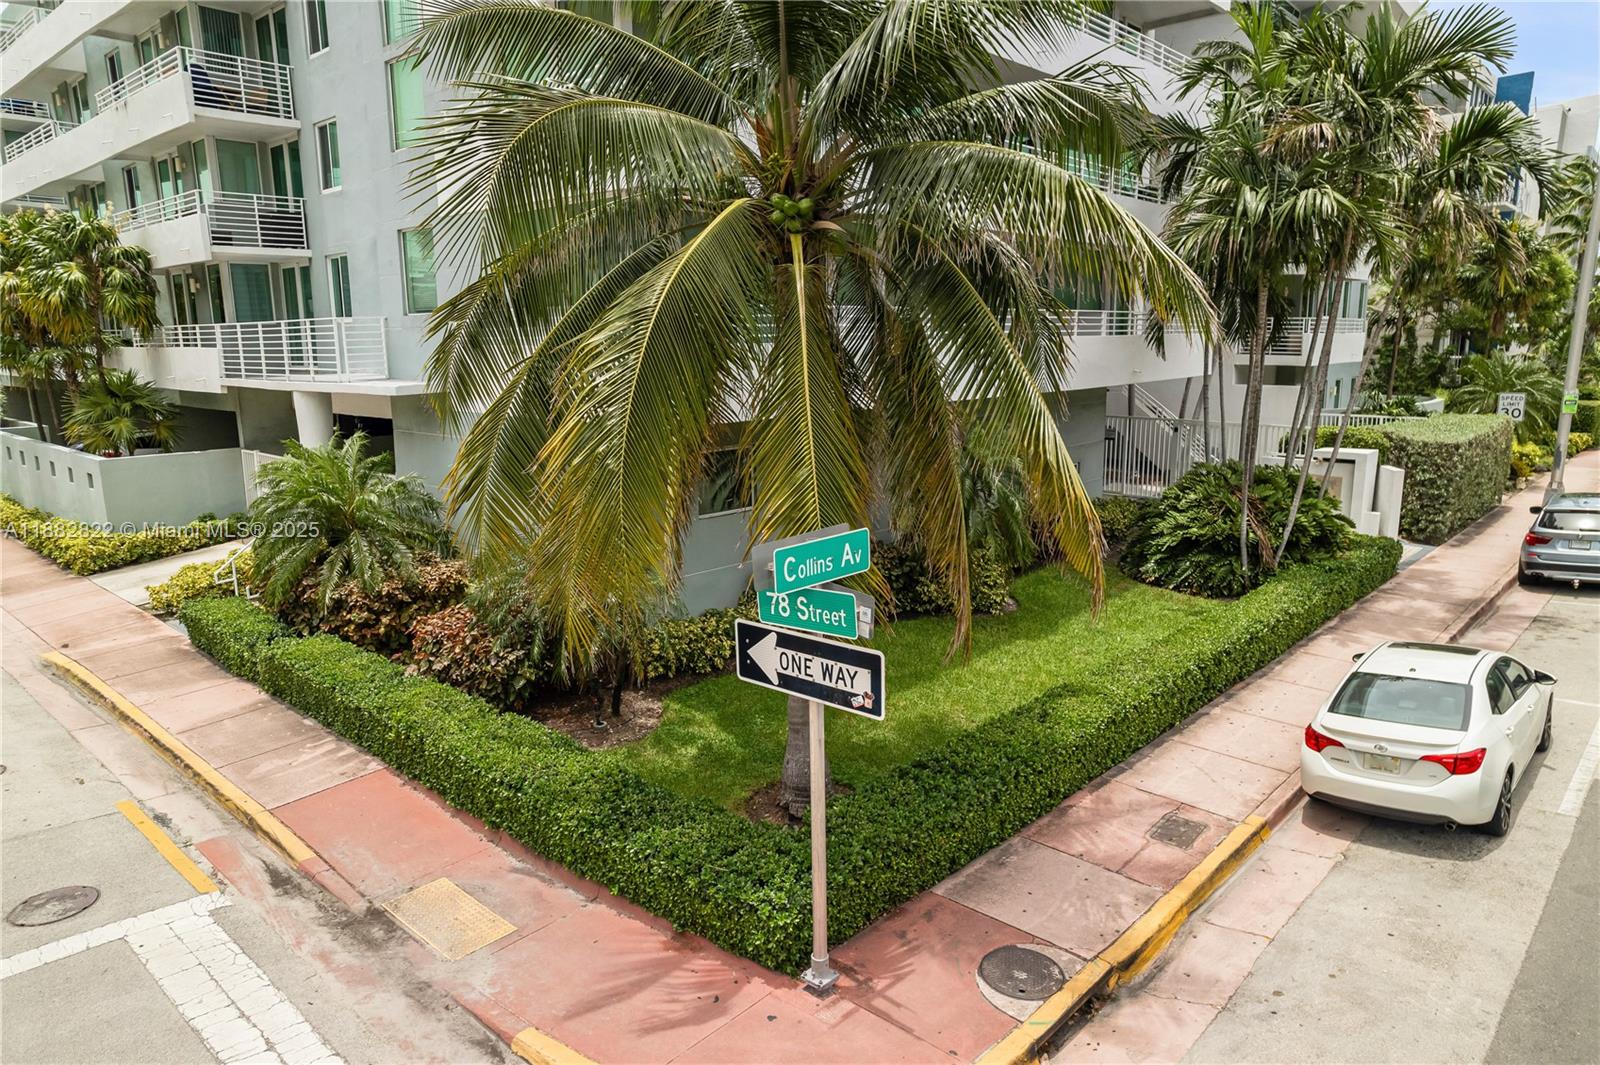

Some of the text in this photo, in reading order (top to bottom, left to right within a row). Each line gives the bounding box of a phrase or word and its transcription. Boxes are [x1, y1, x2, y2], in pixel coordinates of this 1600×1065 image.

[1500, 408, 1522, 419] 30
[783, 542, 862, 582] Collins Av
[766, 591, 791, 617] 78
[796, 596, 848, 628] Street
[779, 651, 859, 689] ONE WAY
